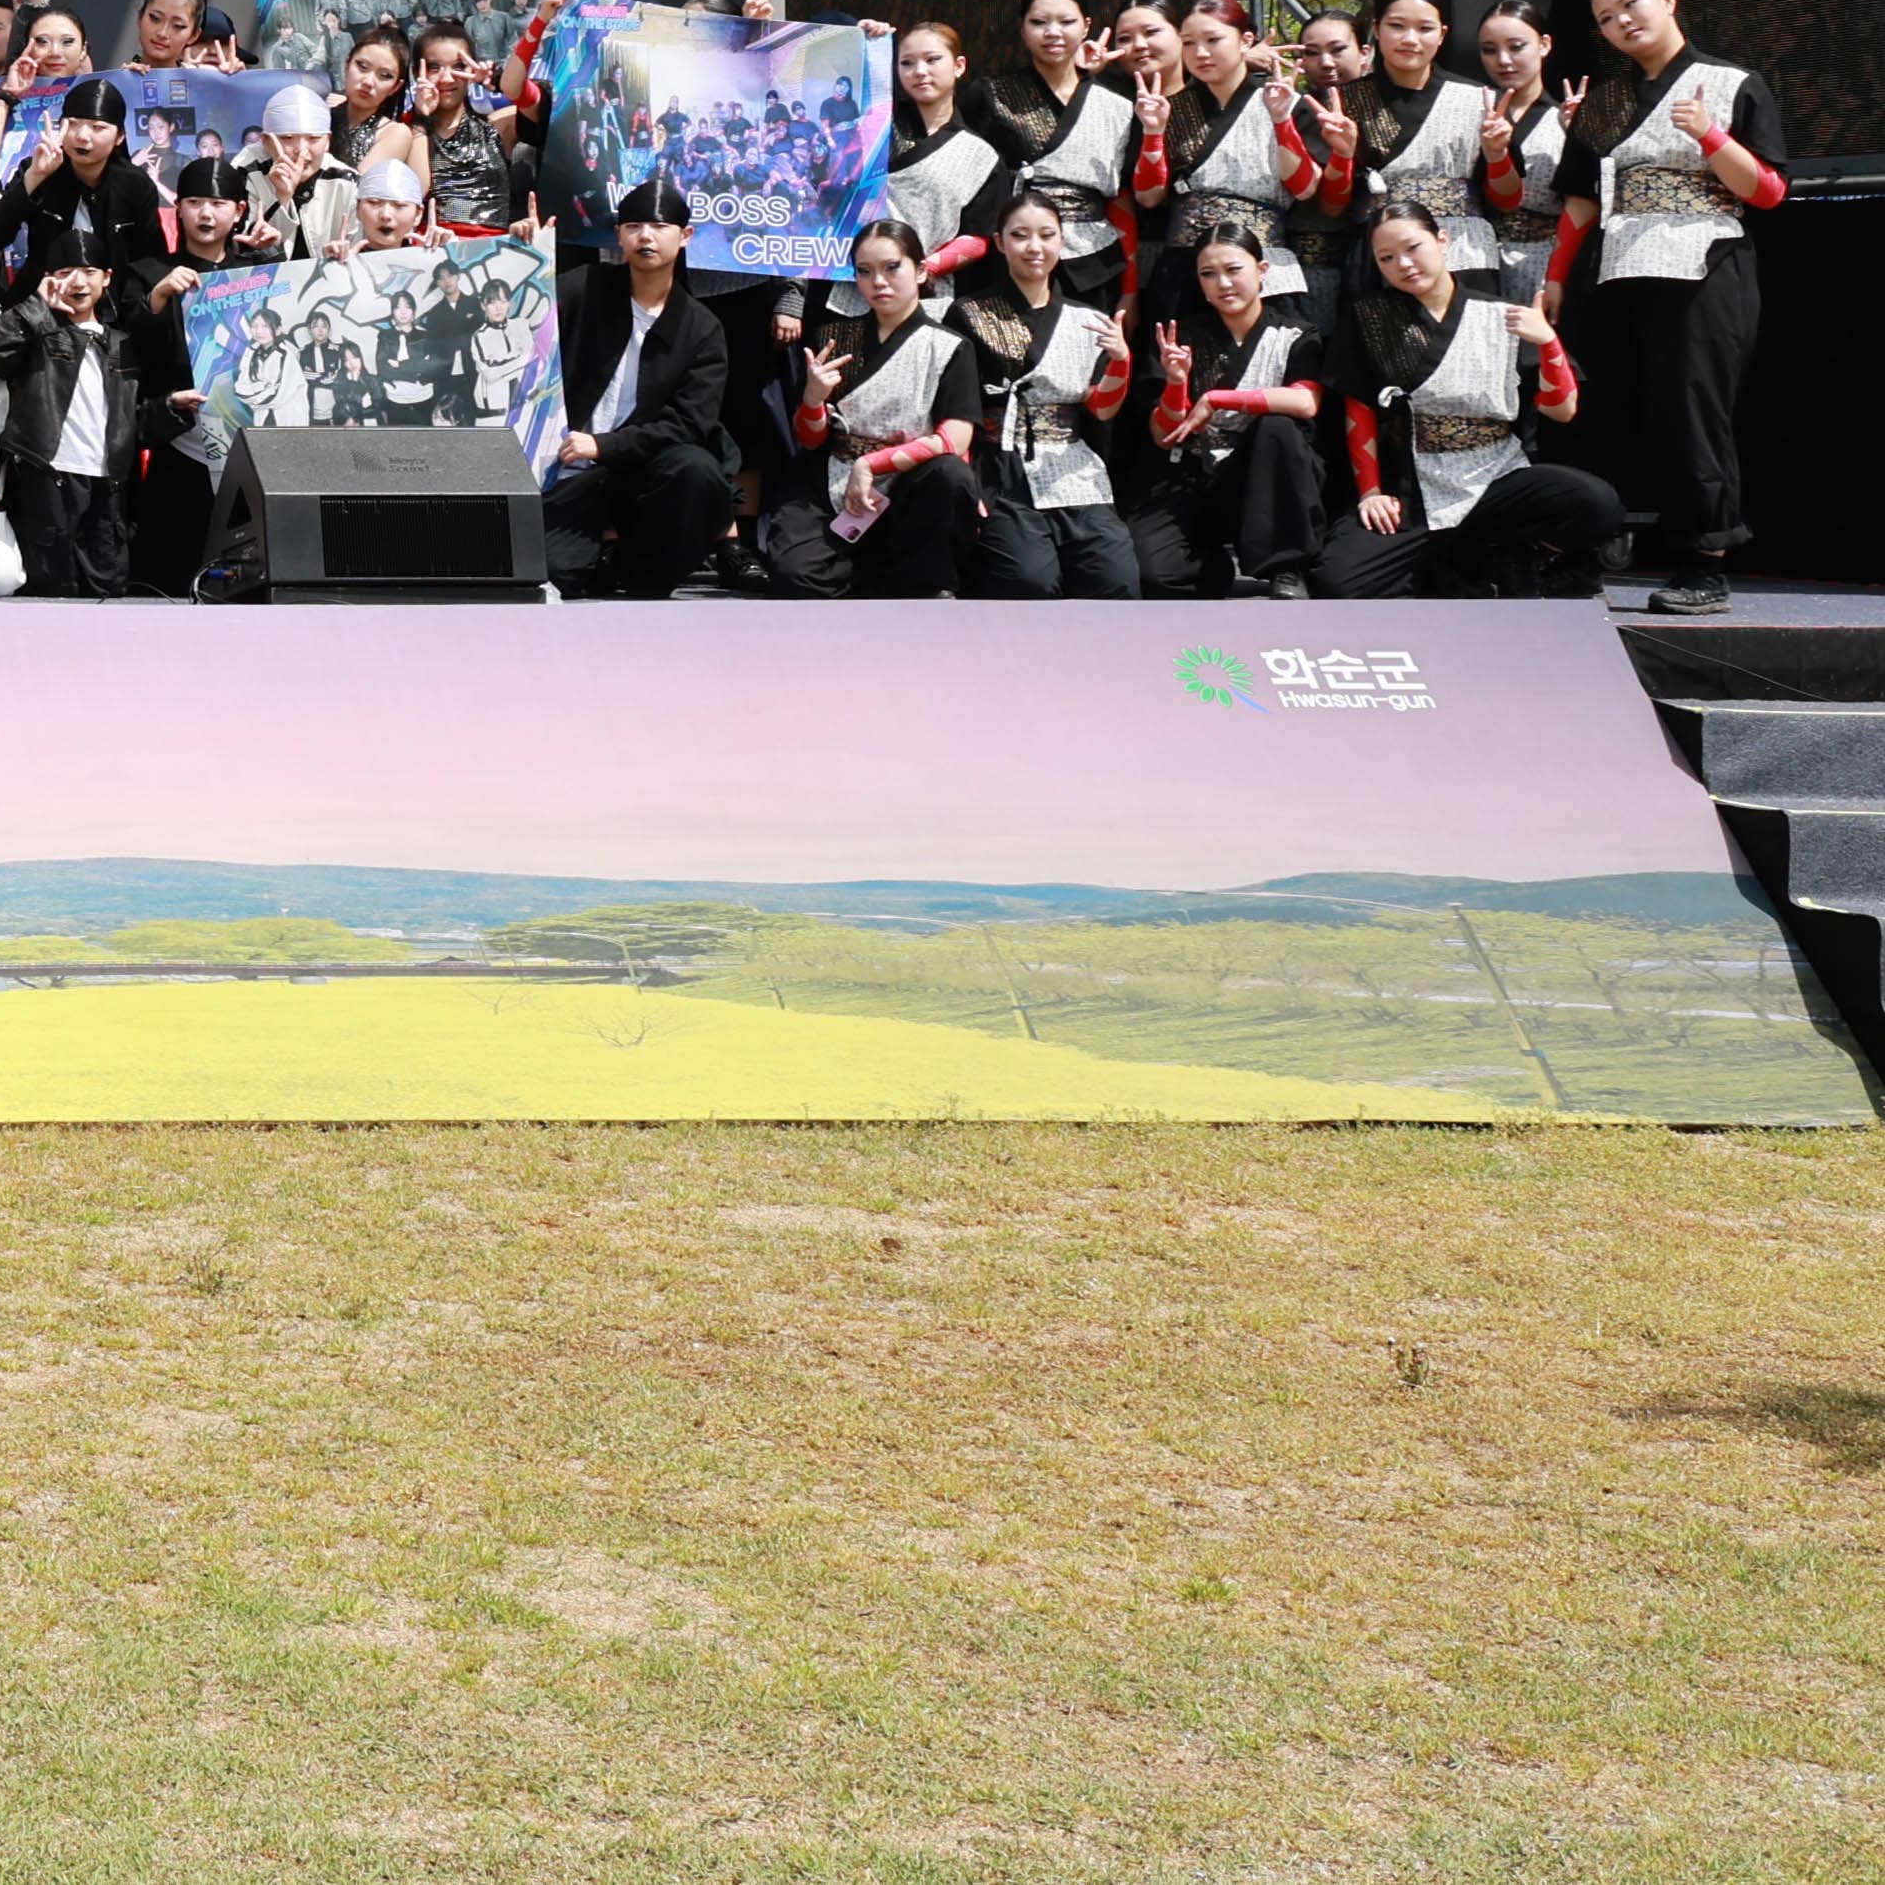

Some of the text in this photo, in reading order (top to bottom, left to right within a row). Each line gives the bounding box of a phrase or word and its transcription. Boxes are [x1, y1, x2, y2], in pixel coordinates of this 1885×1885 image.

[687, 192, 790, 226] BOSS
[732, 233, 854, 266] CREW
[190, 280, 291, 318] ON THE STAGE
[1259, 648, 1428, 690] 화순군
[1278, 690, 1437, 712] Hwasun-gun
